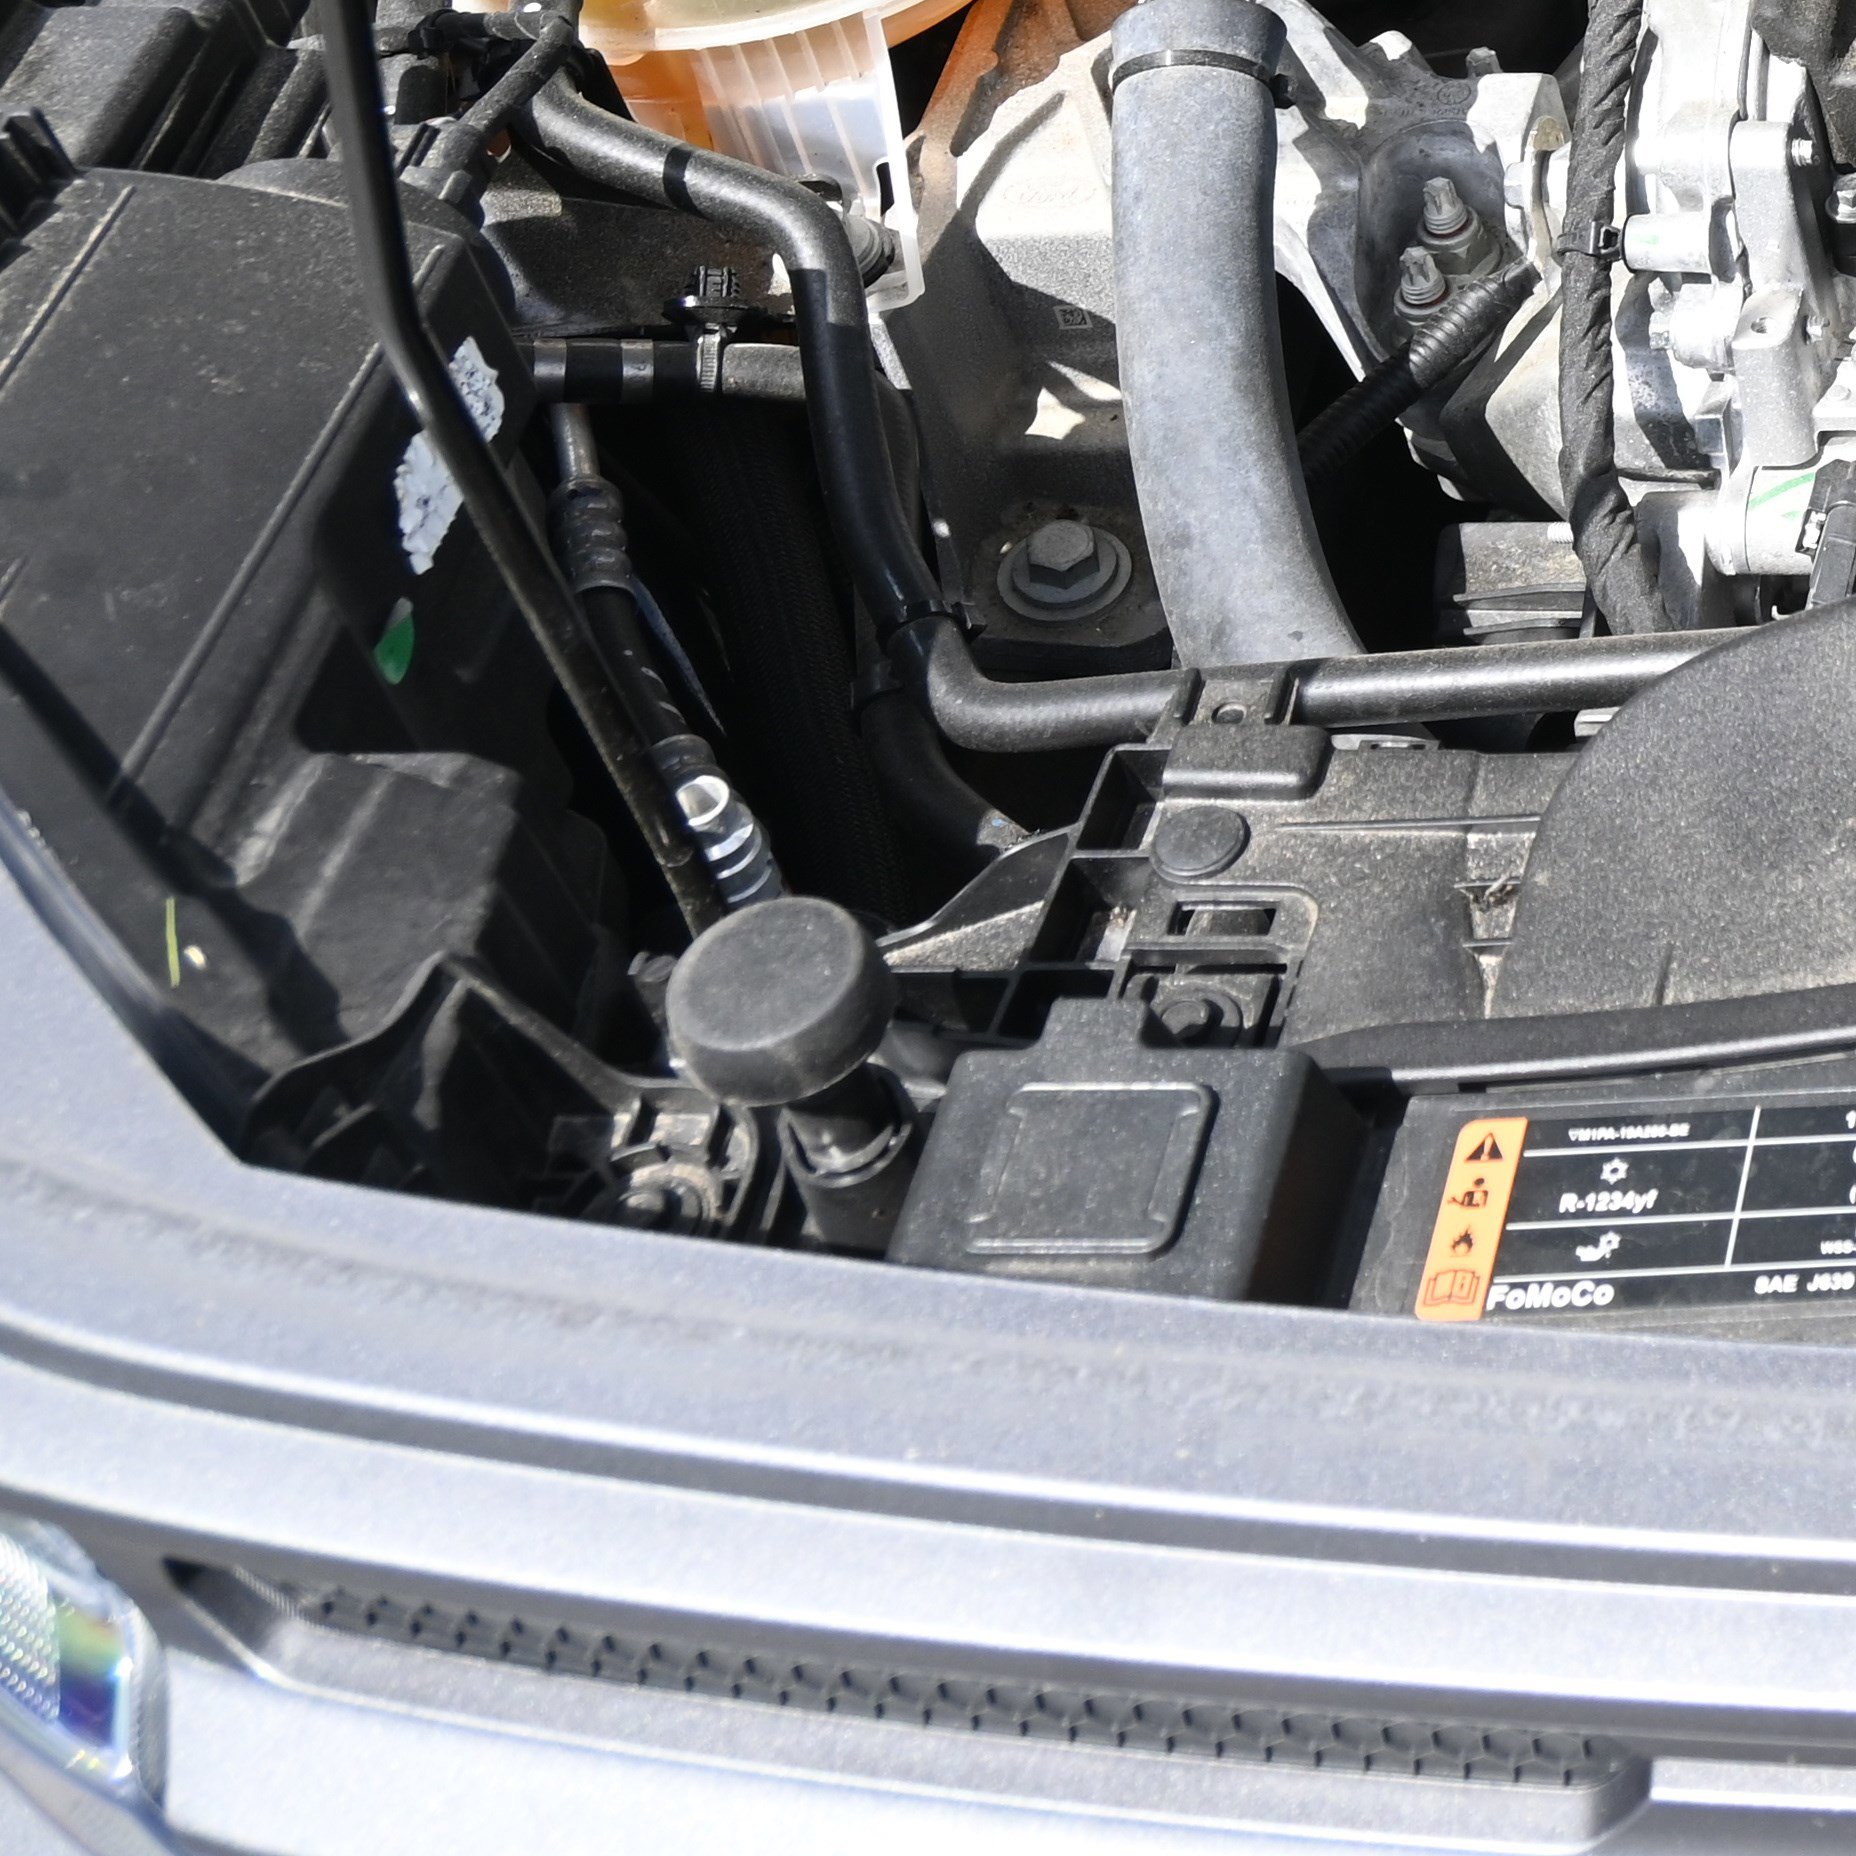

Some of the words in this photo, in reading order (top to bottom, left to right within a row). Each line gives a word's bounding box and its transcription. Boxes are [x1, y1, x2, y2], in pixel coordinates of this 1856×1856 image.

[1558, 1188, 1659, 1213] R-1234yf
[1486, 1280, 1614, 1311] FoMoCo
[1754, 1274, 1799, 1294] SAE
